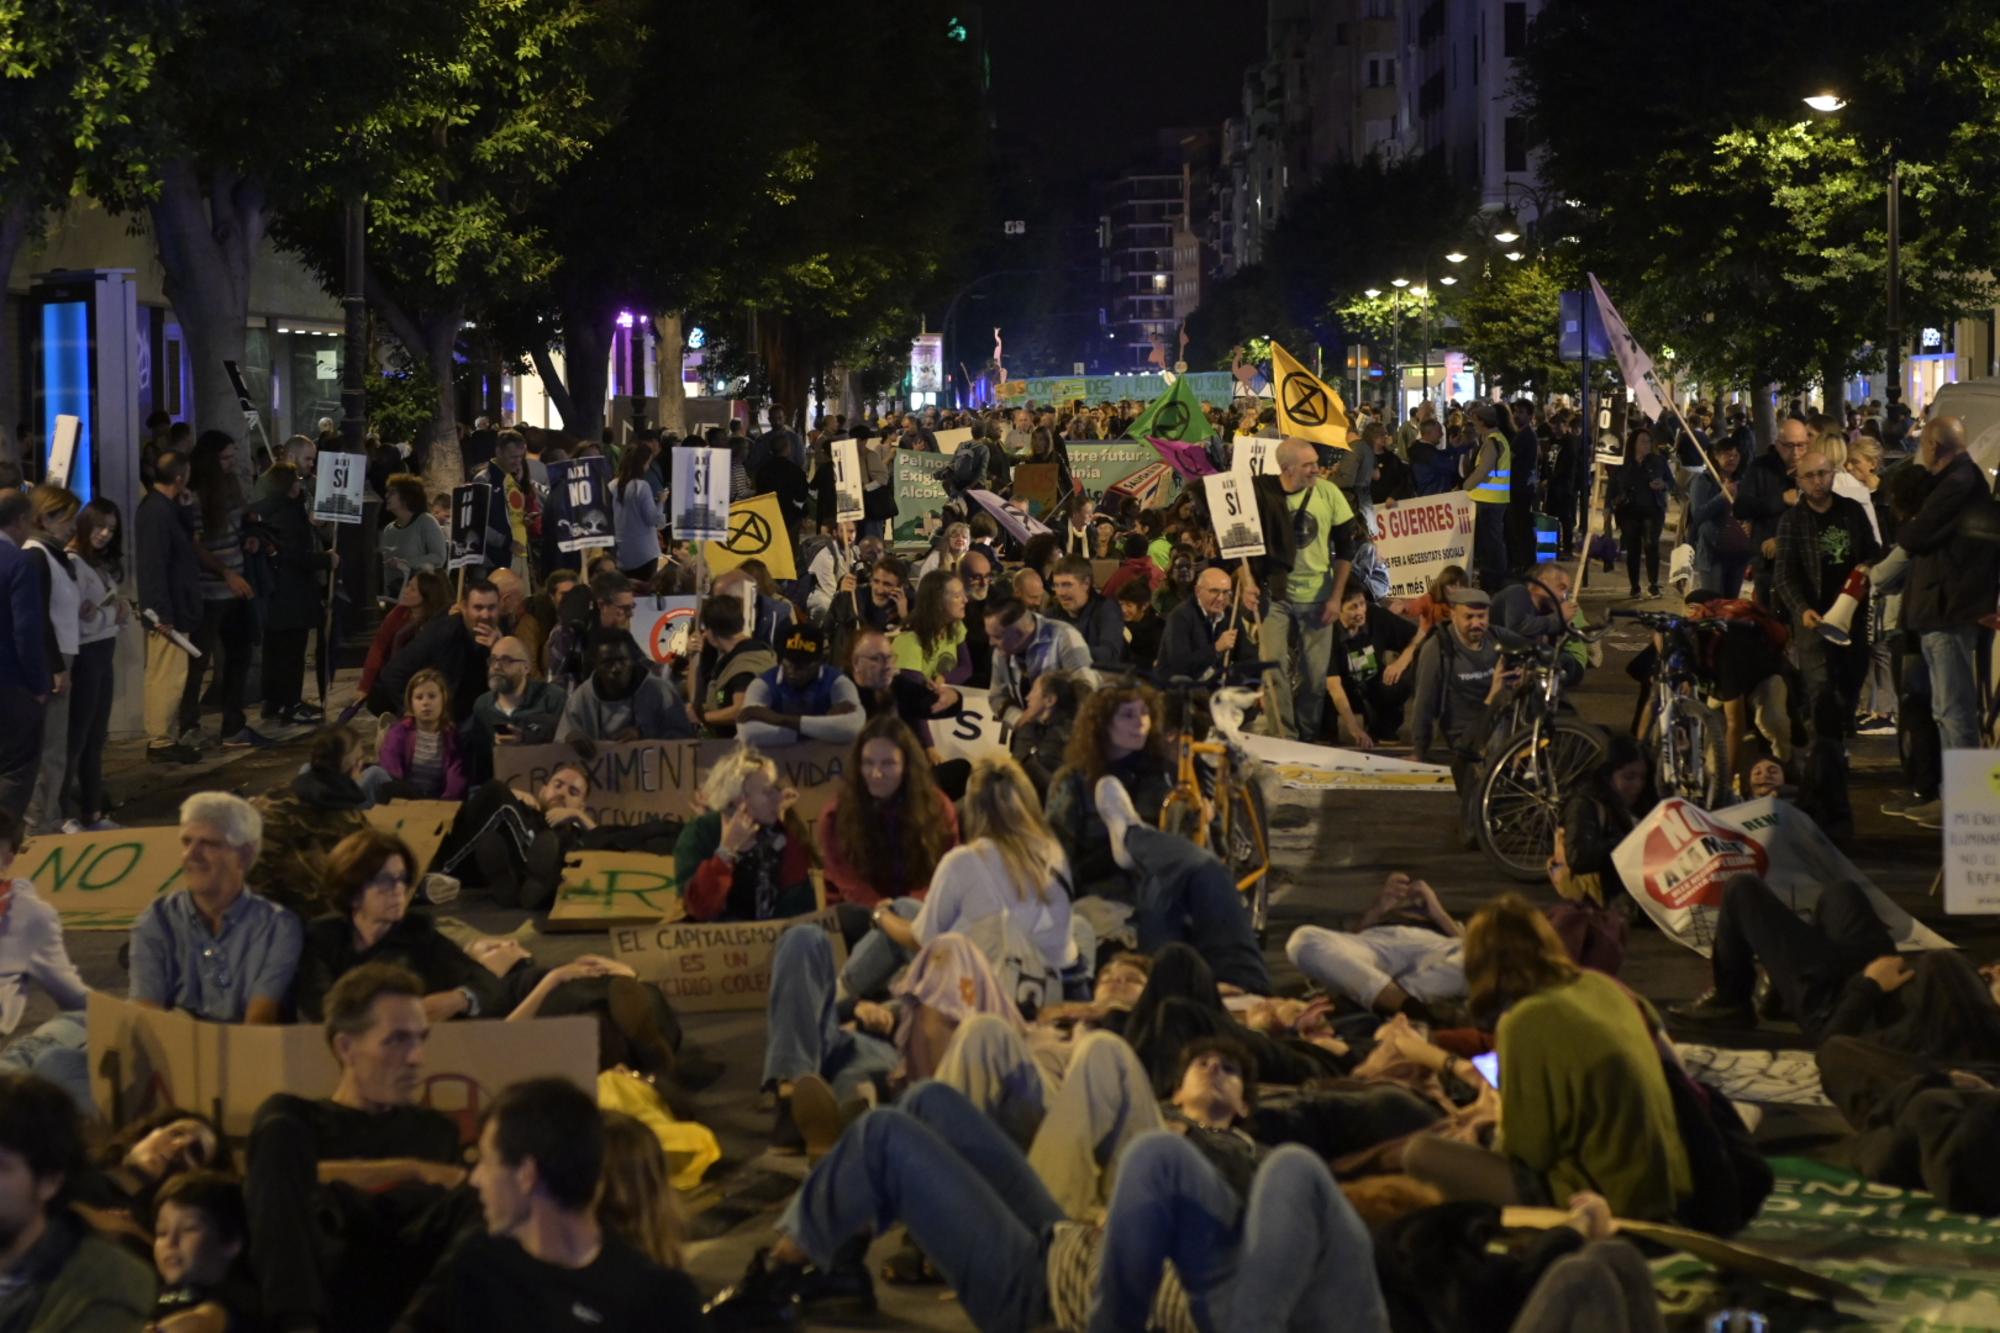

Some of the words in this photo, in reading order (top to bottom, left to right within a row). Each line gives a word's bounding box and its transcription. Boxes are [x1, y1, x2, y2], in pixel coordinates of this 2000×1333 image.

[900, 453, 922, 467] Pel
[568, 480, 593, 507] NO
[1389, 503, 1454, 538] GUERRES
[1407, 576, 1425, 594] més
[30, 842, 144, 893] NO
[616, 930, 647, 953] EL
[656, 926, 778, 950] CAPITALISMO
[680, 954, 705, 973] ES
[723, 951, 748, 969] UN
